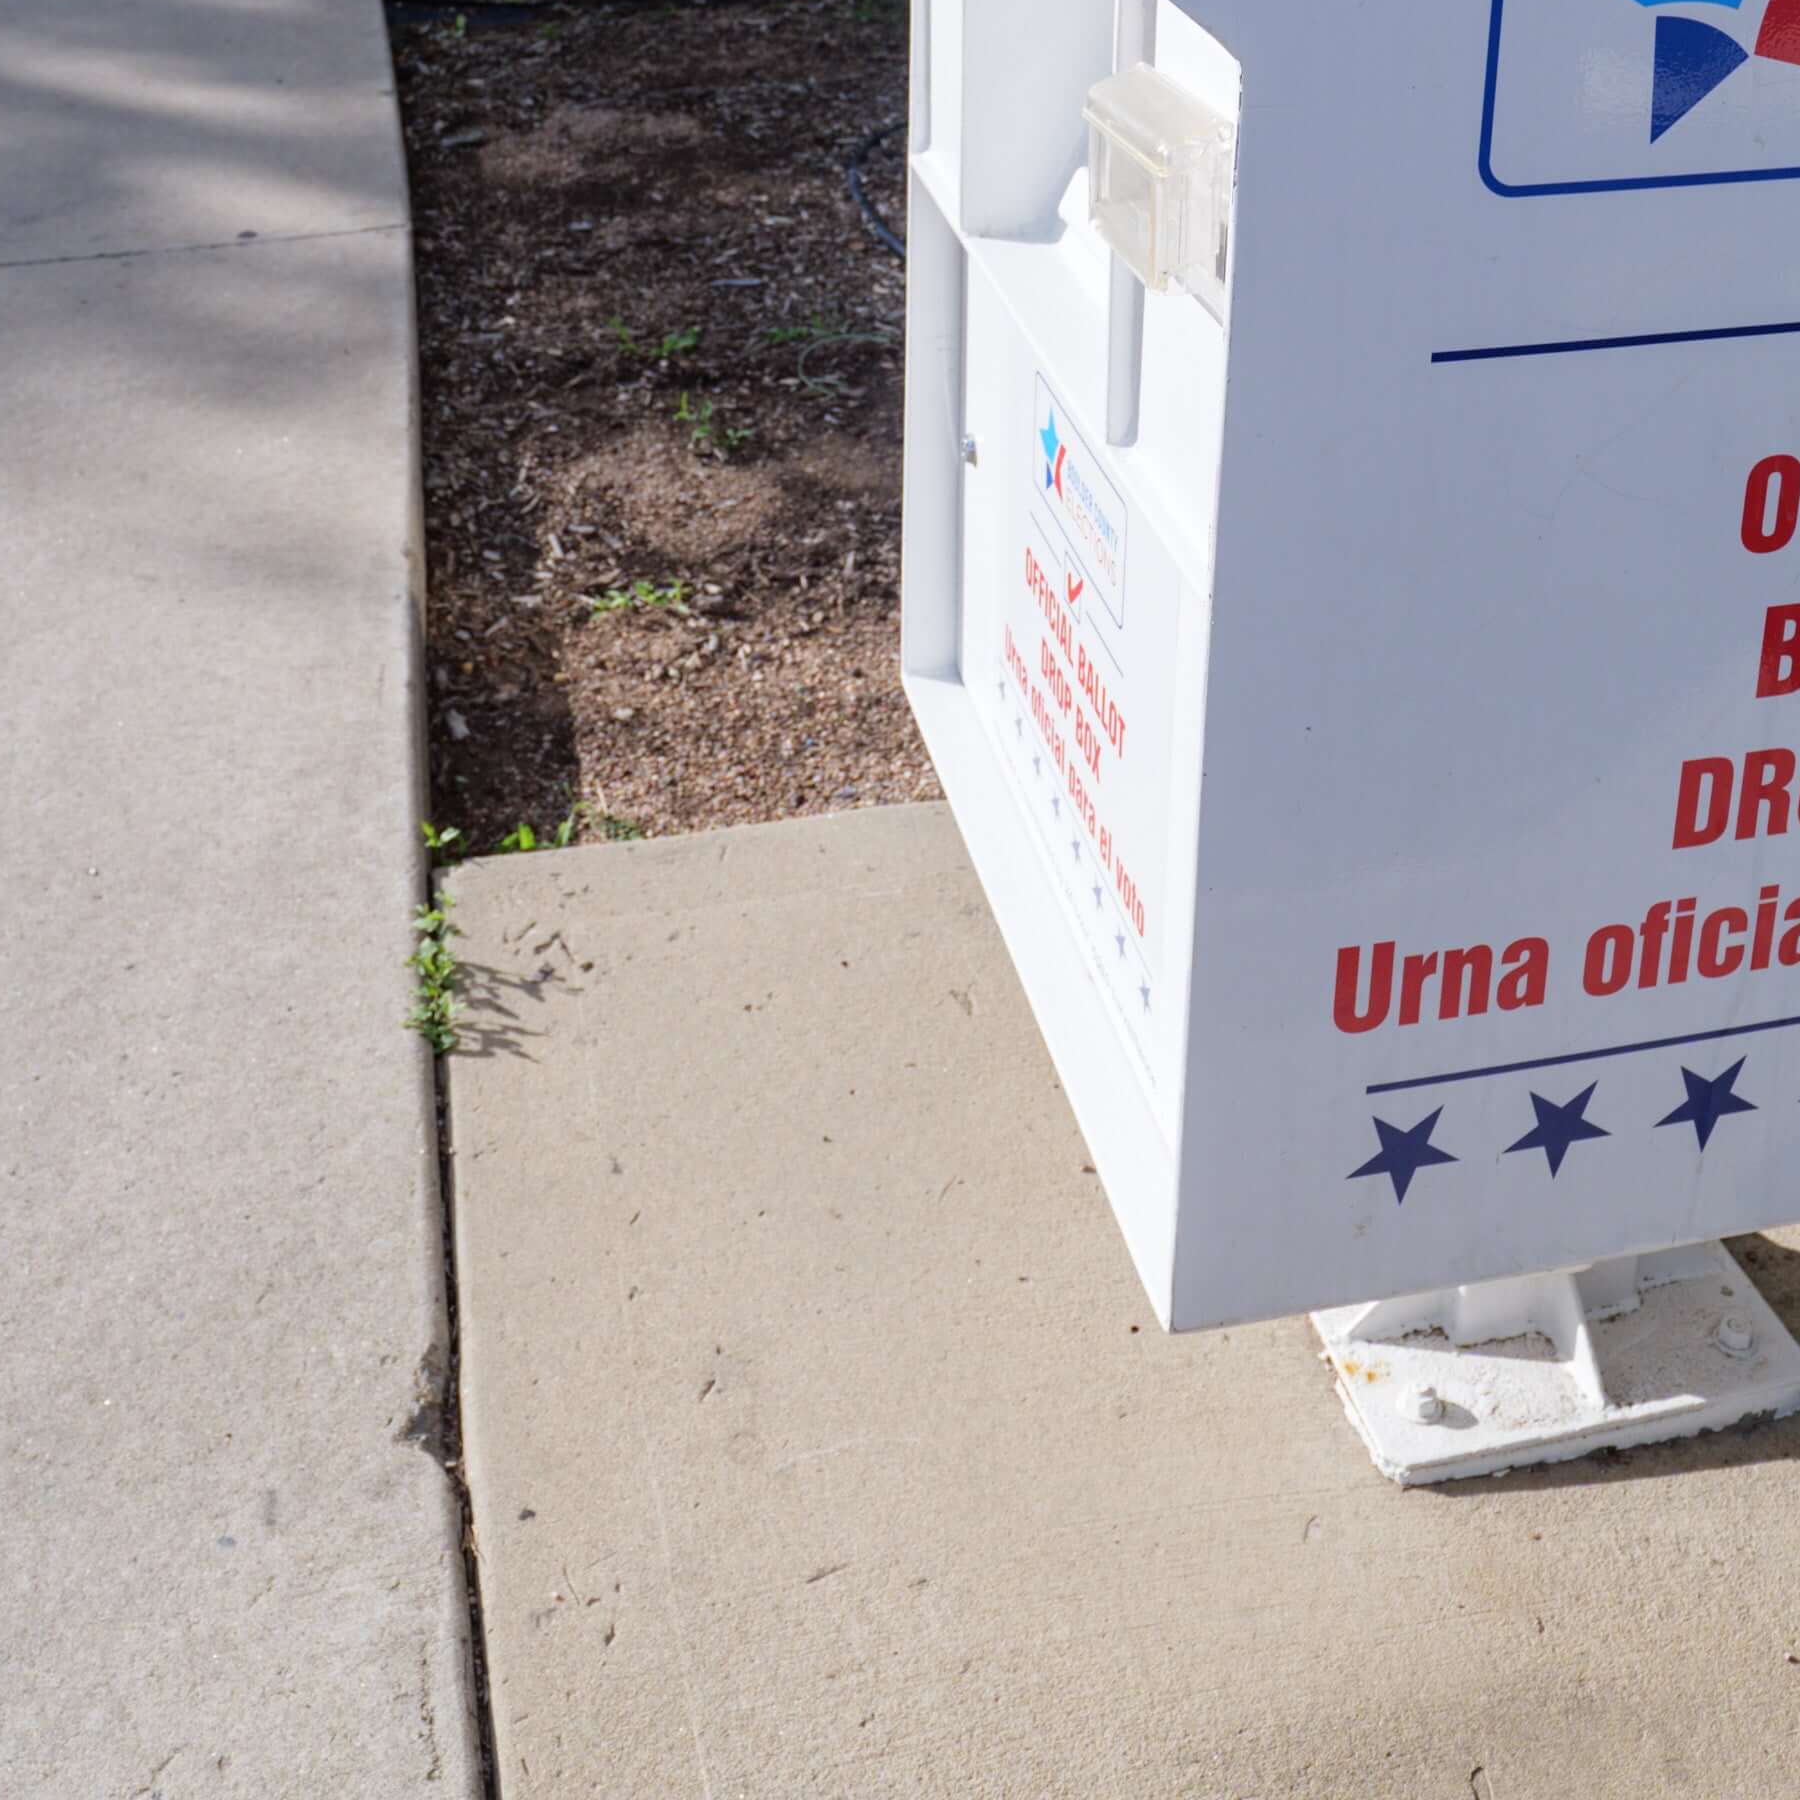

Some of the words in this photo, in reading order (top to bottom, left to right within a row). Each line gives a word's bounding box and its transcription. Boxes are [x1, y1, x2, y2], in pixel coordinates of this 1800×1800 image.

[1065, 485, 1117, 587] ELECTIONS
[1025, 546, 1074, 668] OFFICIAL
[1076, 643, 1127, 759] BALLOT
[1040, 635, 1073, 719] DROP
[1074, 703, 1102, 784] BOX
[1004, 622, 1029, 696] Urna
[1031, 684, 1066, 776] oficial
[1067, 760, 1096, 839] para
[1099, 824, 1113, 872] el
[1115, 855, 1145, 937] voto
[1332, 937, 1549, 1034] Urna
